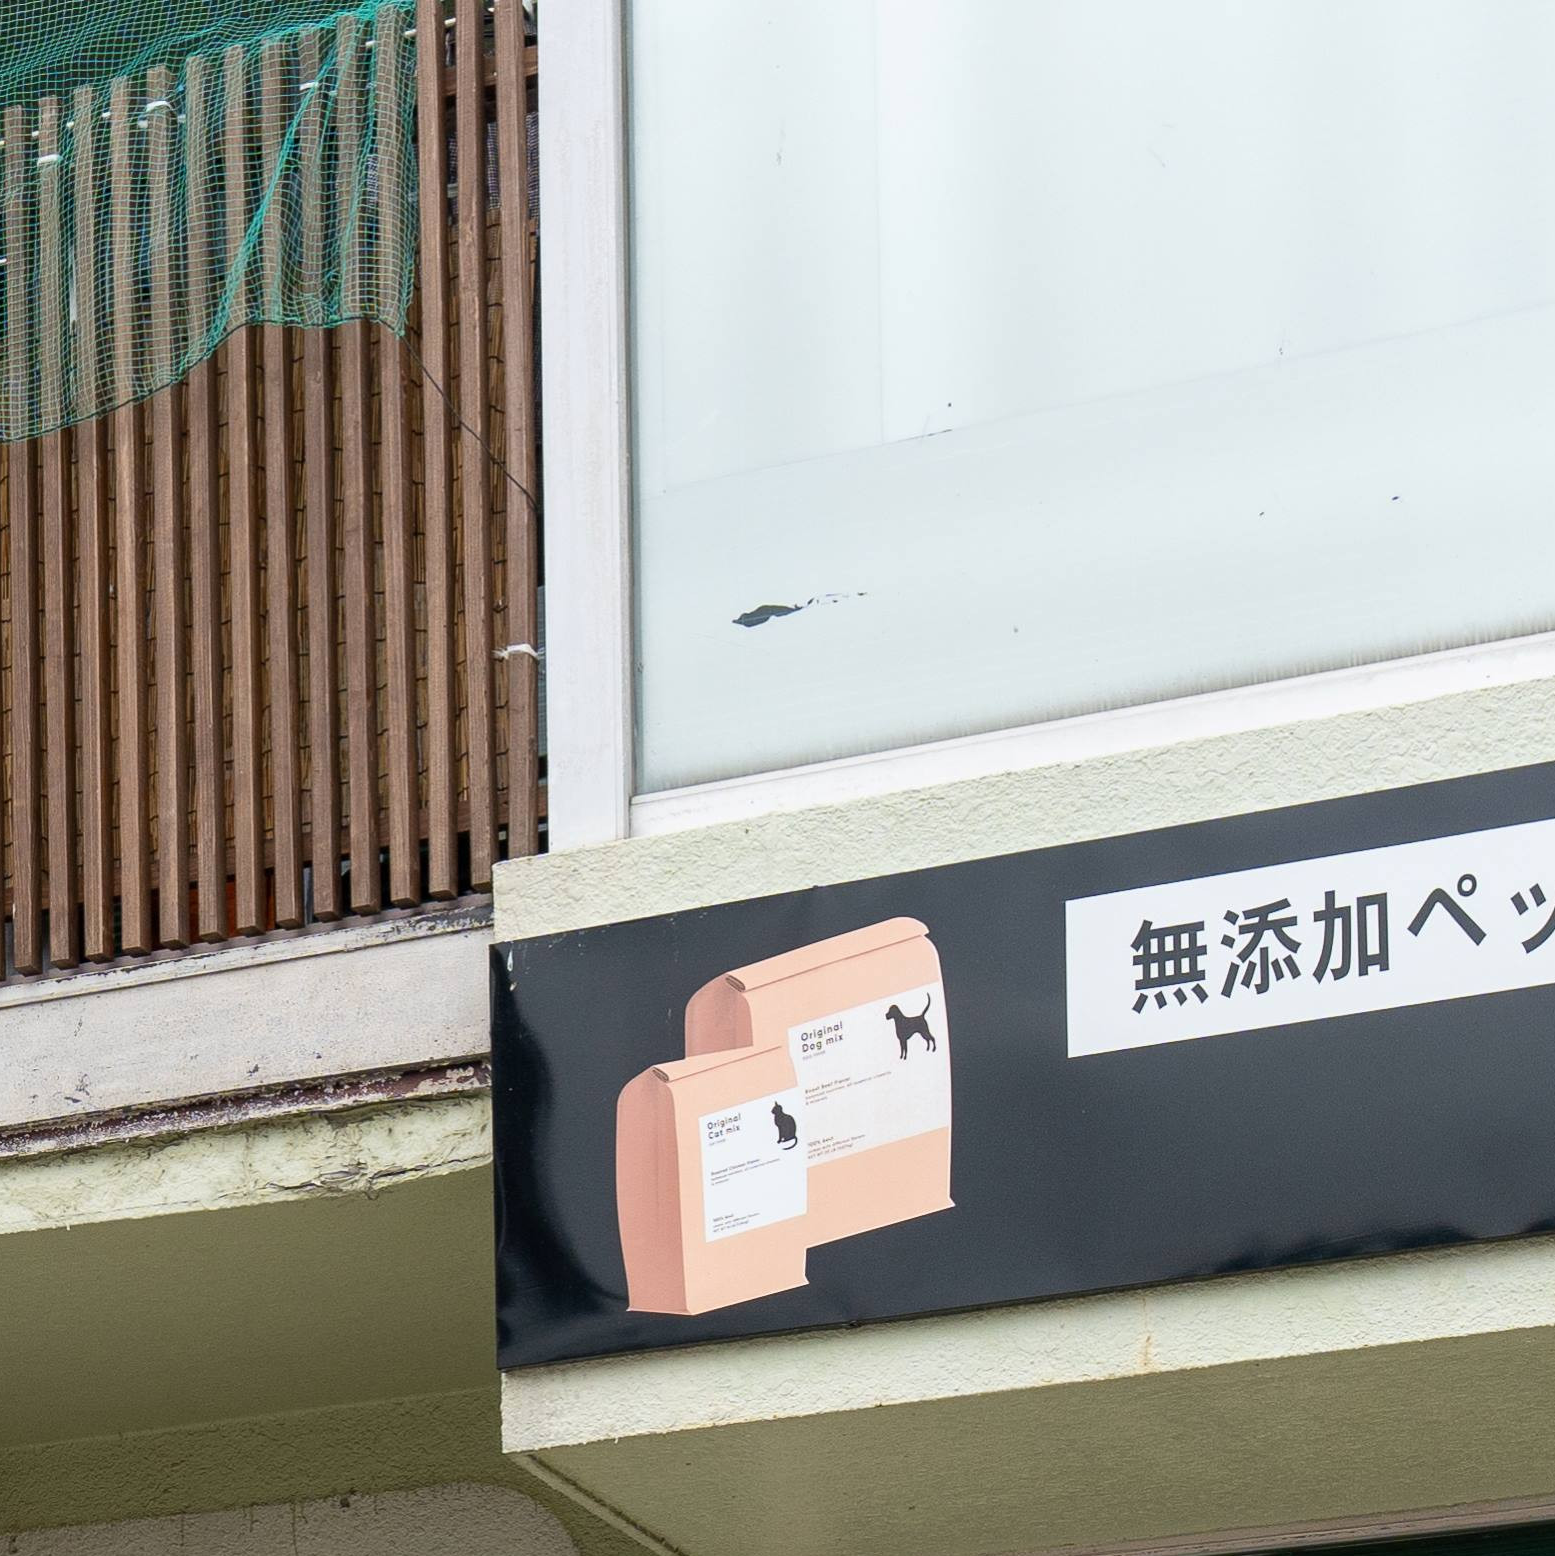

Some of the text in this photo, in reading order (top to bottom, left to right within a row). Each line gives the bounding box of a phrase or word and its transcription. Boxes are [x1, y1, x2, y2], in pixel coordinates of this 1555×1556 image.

[801, 1021, 843, 1042] Original
[802, 1033, 843, 1053] Dog mix
[707, 1113, 742, 1130] Original
